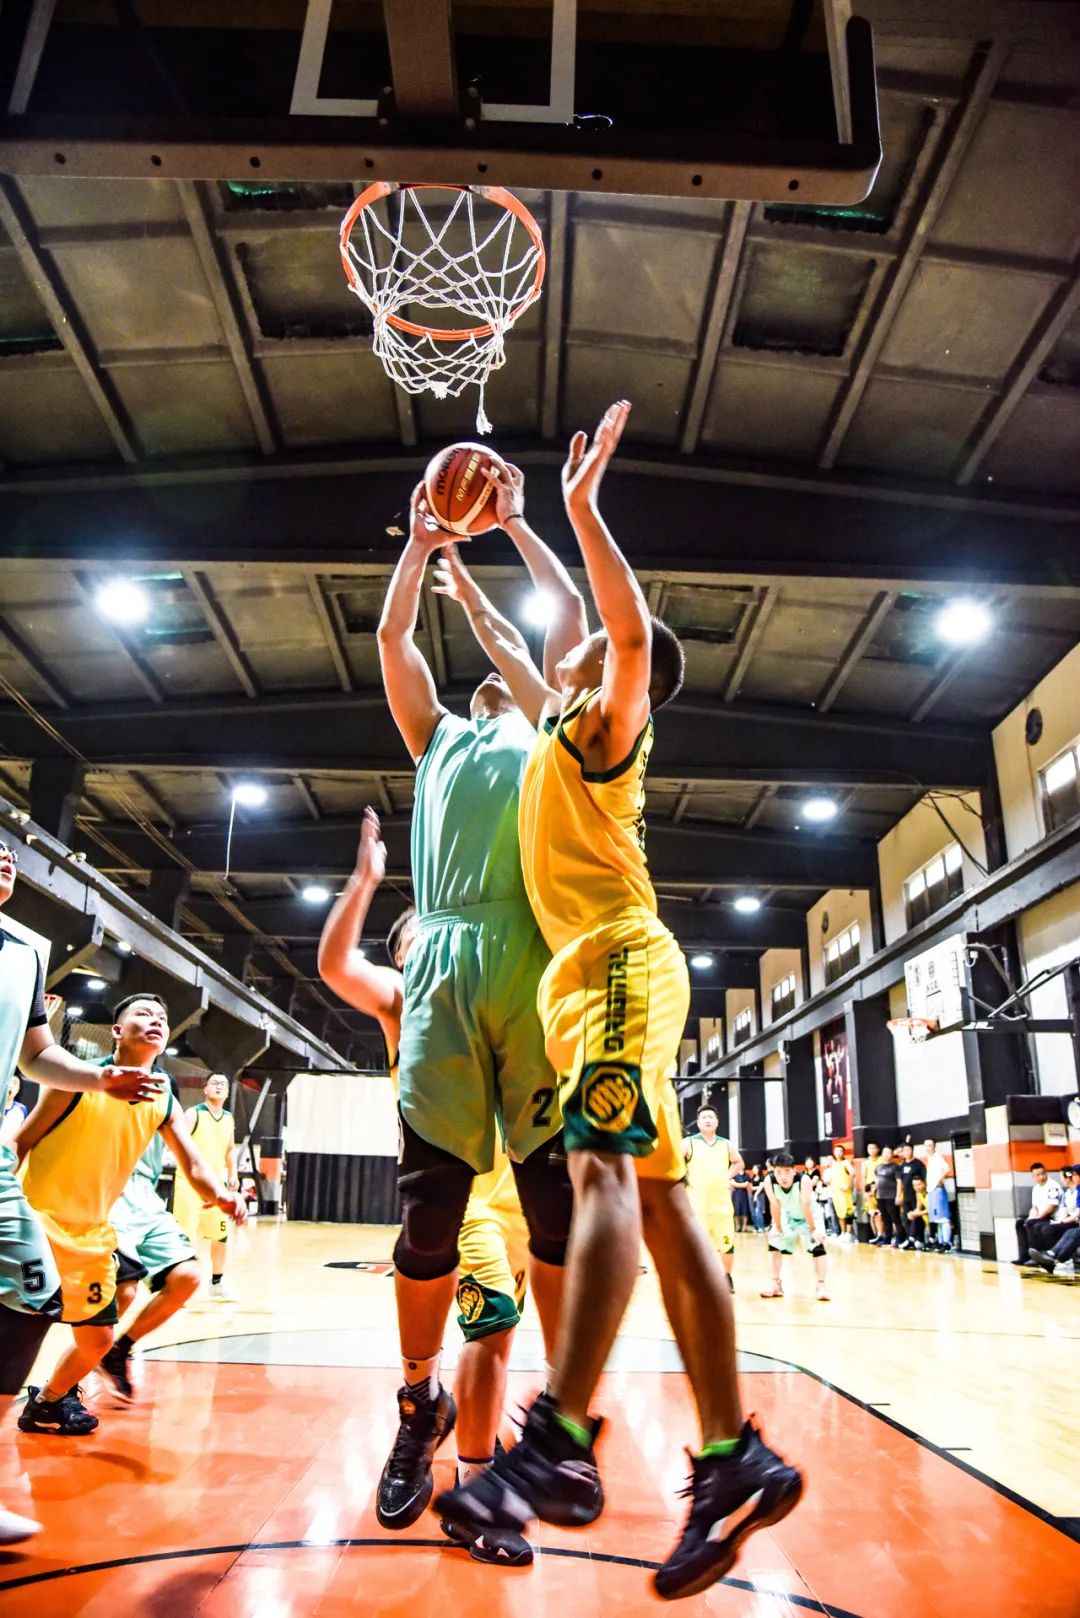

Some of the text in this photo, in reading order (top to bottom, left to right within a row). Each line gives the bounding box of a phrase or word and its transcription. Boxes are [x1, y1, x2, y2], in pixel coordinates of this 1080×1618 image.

[531, 1087, 555, 1128] 2
[220, 1220, 226, 1232] 5
[21, 1258, 46, 1294] 5
[87, 1282, 102, 1304] 3
